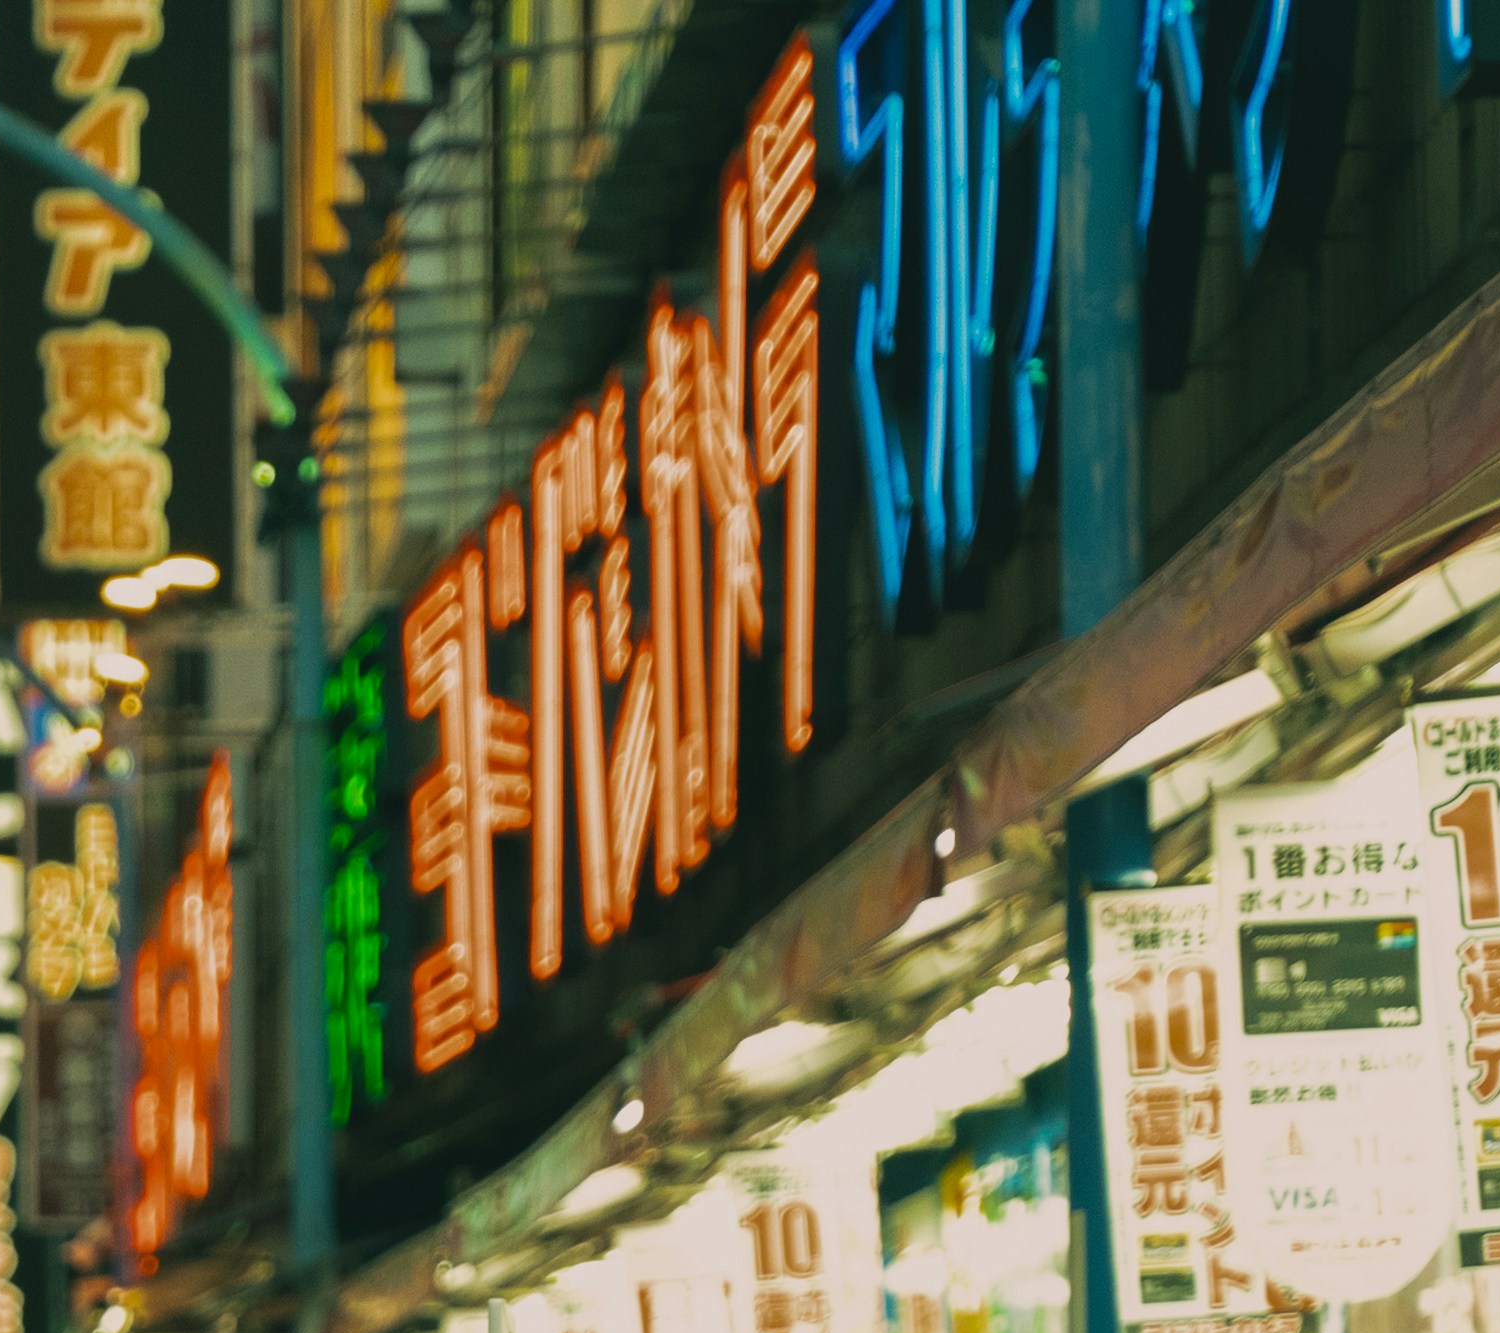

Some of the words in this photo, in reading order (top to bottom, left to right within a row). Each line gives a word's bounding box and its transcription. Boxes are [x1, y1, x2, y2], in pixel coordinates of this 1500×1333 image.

[1241, 841, 1420, 880] 1番お得な
[1268, 1185, 1340, 1211] VISA
[738, 1202, 824, 1281] 10
